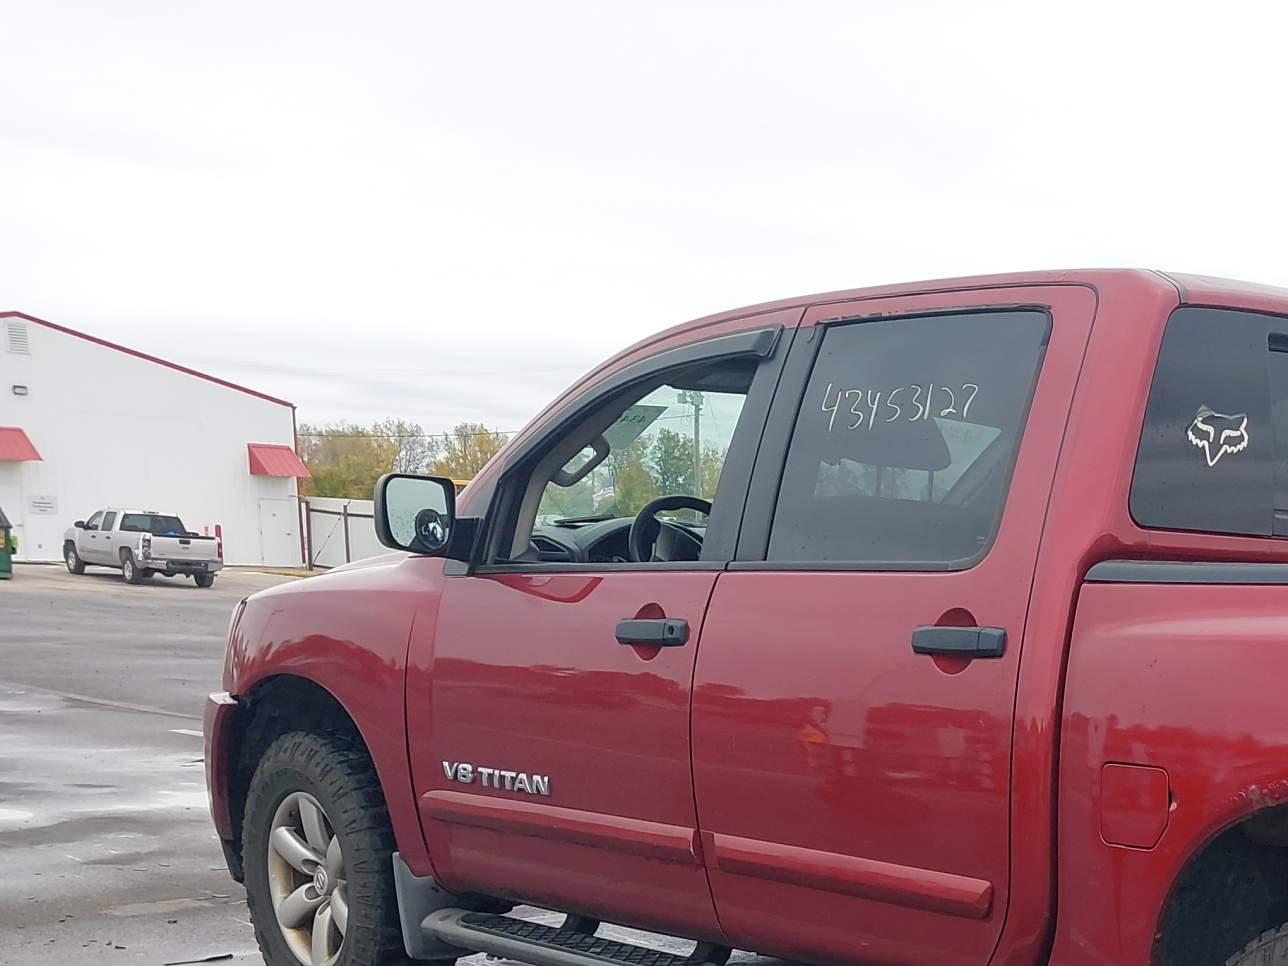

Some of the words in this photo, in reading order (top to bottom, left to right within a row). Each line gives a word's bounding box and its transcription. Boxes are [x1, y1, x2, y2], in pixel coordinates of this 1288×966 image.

[821, 383, 979, 432] 43453127
[442, 761, 474, 783] V8
[477, 766, 550, 796] TITAN
